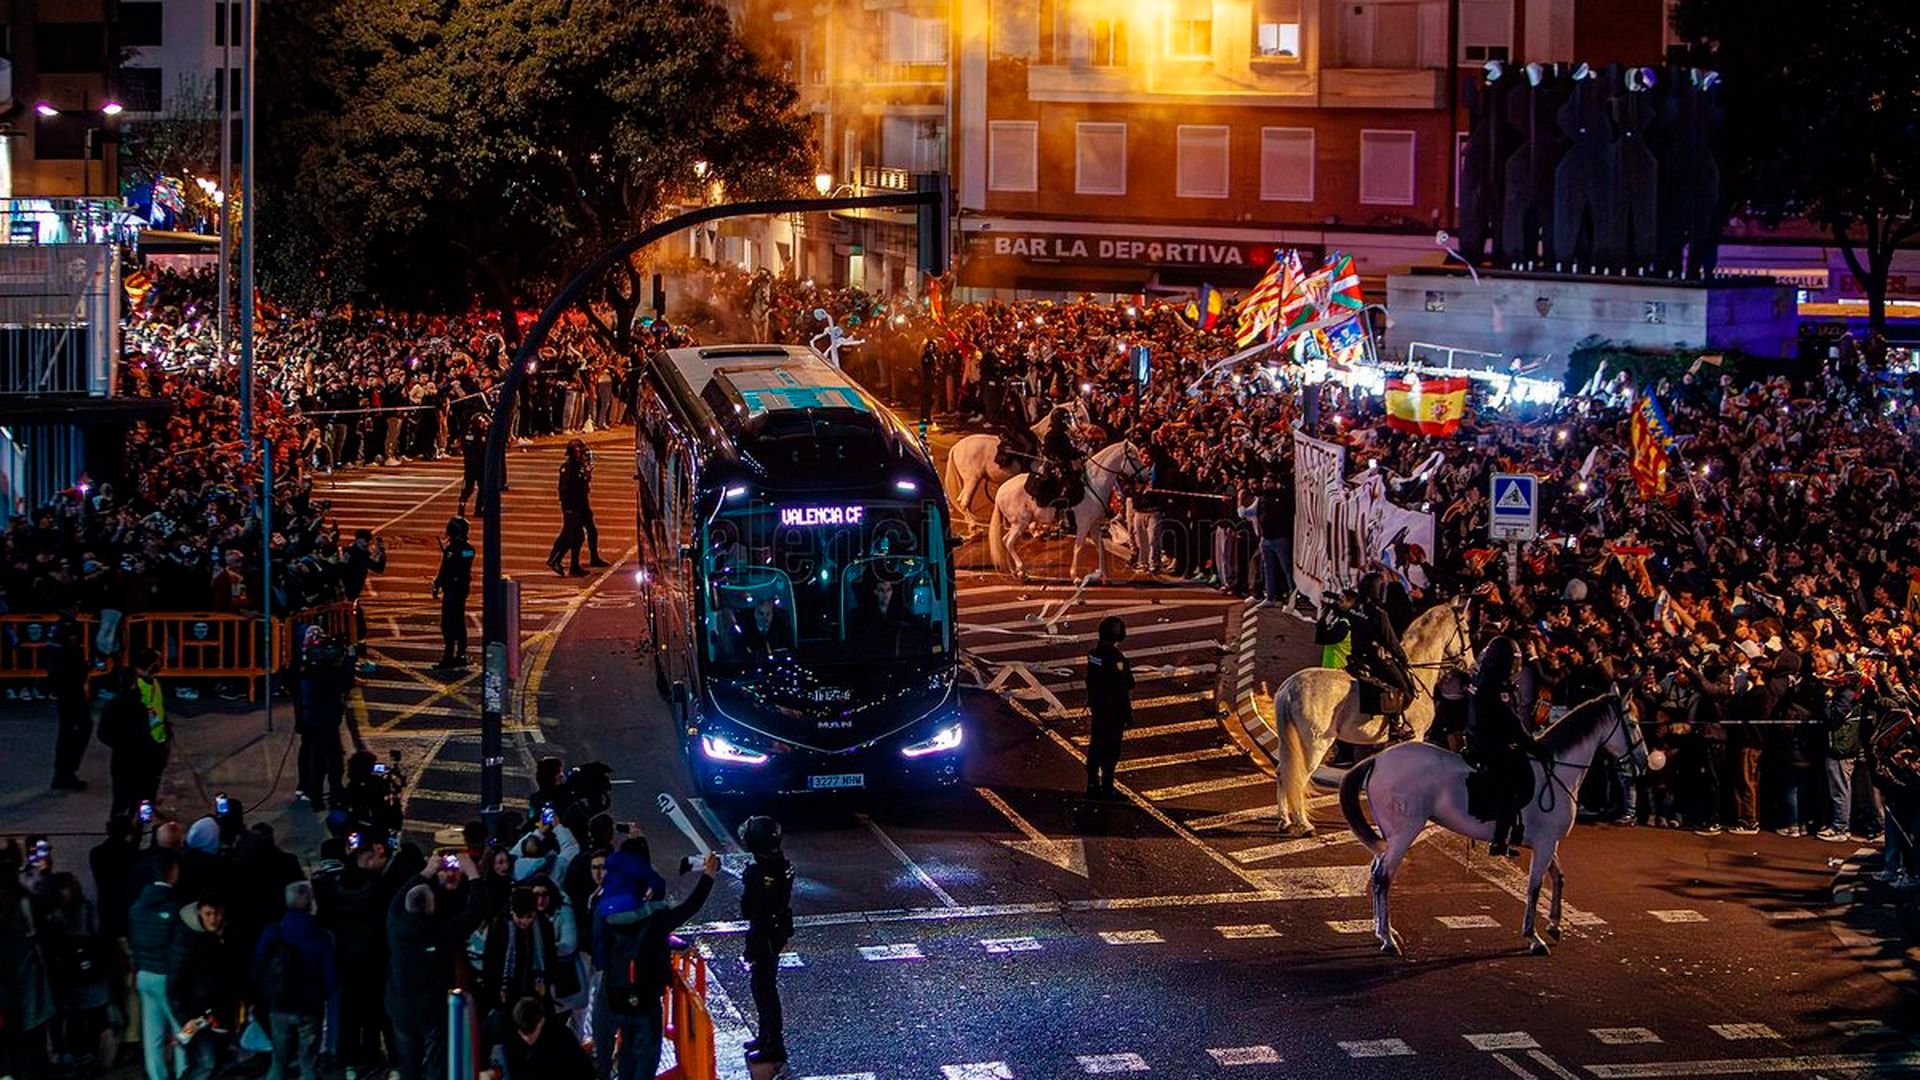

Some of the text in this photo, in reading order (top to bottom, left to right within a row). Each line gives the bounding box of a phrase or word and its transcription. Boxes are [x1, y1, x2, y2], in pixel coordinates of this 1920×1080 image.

[995, 237, 1243, 264] BAR LA DEPORTIVA
[781, 506, 864, 525] VALENCIA CF
